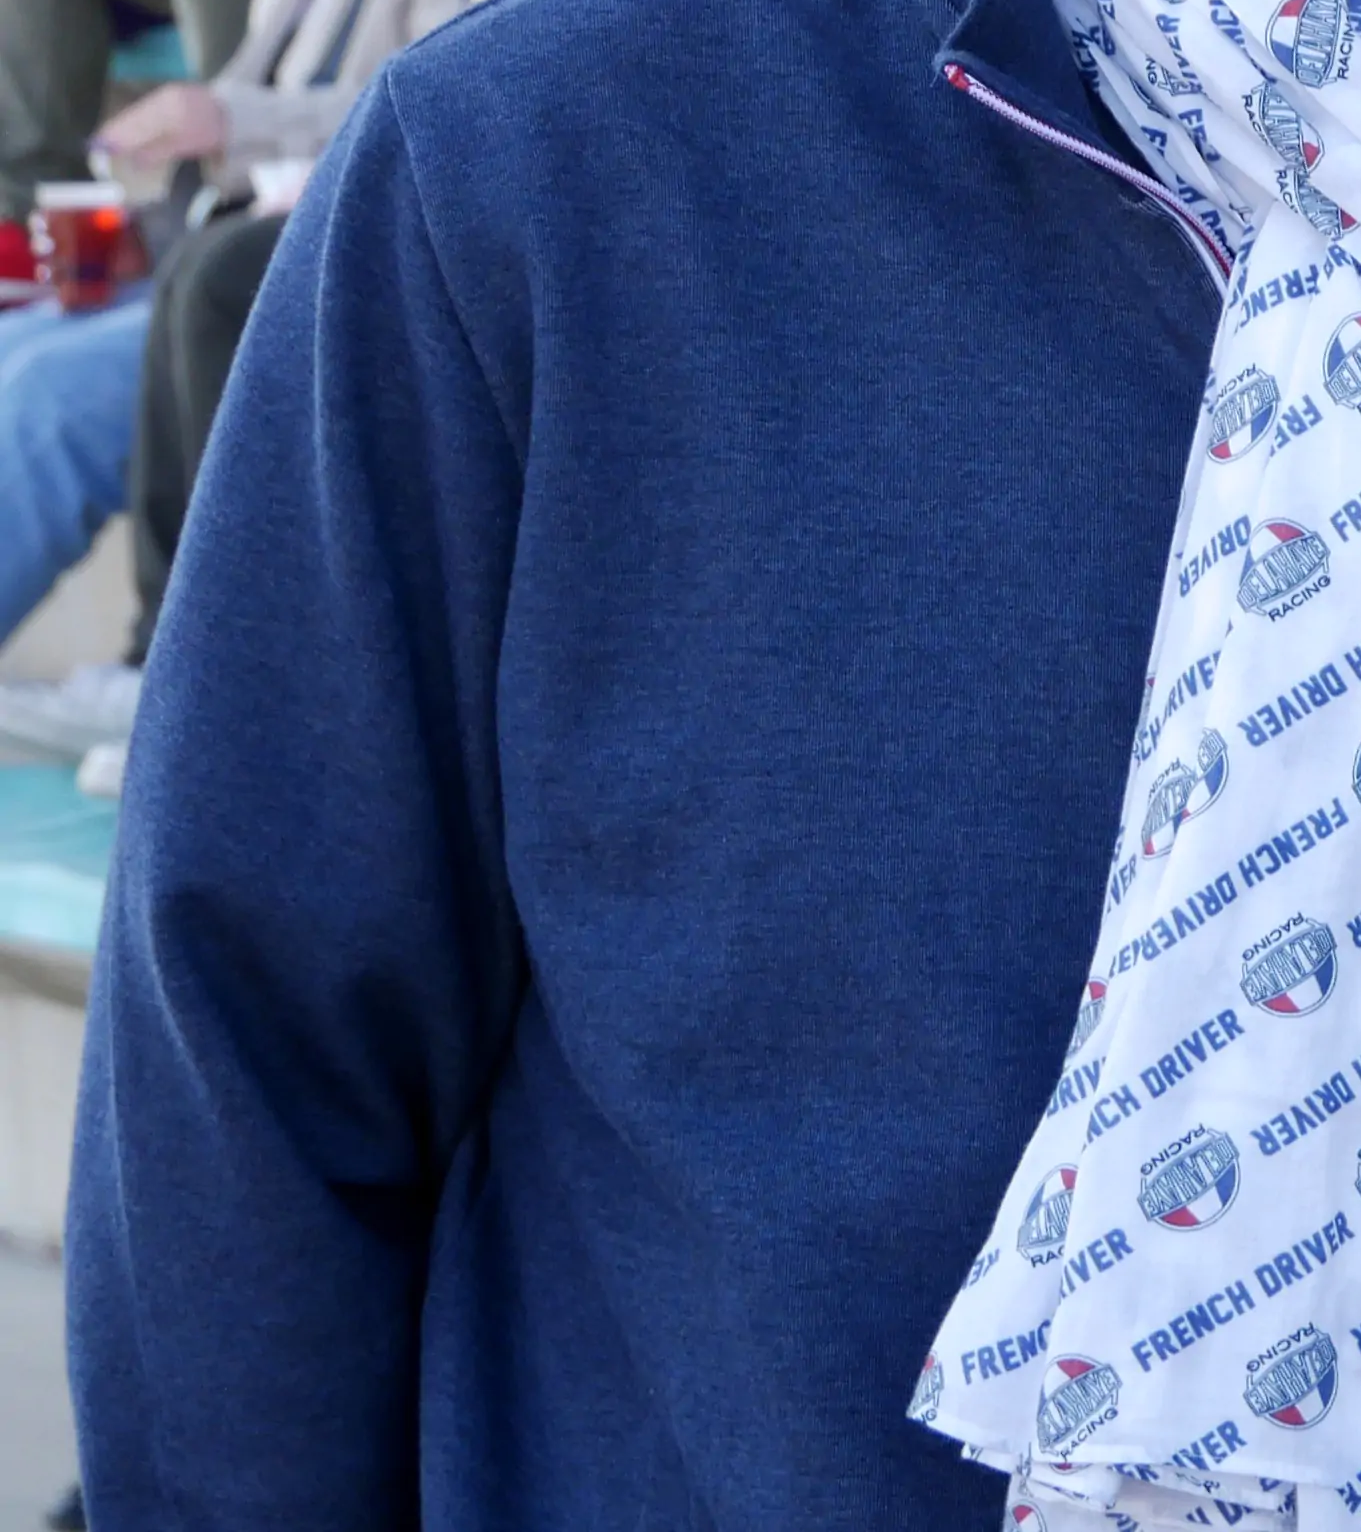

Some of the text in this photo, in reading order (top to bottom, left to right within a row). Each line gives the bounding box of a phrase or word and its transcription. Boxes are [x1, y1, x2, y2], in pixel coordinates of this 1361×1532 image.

[1176, 514, 1252, 599] DRIVER
[1267, 574, 1331, 623] RACING
[1236, 662, 1349, 748] DRIVER
[1237, 797, 1350, 889] FRENCH
[1139, 870, 1239, 962] DRIVER
[1241, 911, 1305, 962] RACING
[1139, 1008, 1245, 1100] DRIVER
[1139, 1122, 1207, 1176] RACING
[1250, 1070, 1357, 1157] DRIVER
[1130, 1279, 1257, 1374] FRENCH
[1253, 1210, 1355, 1298] DRIVER
[960, 1319, 1053, 1386] FRENC
[1245, 1321, 1316, 1373] RACING
